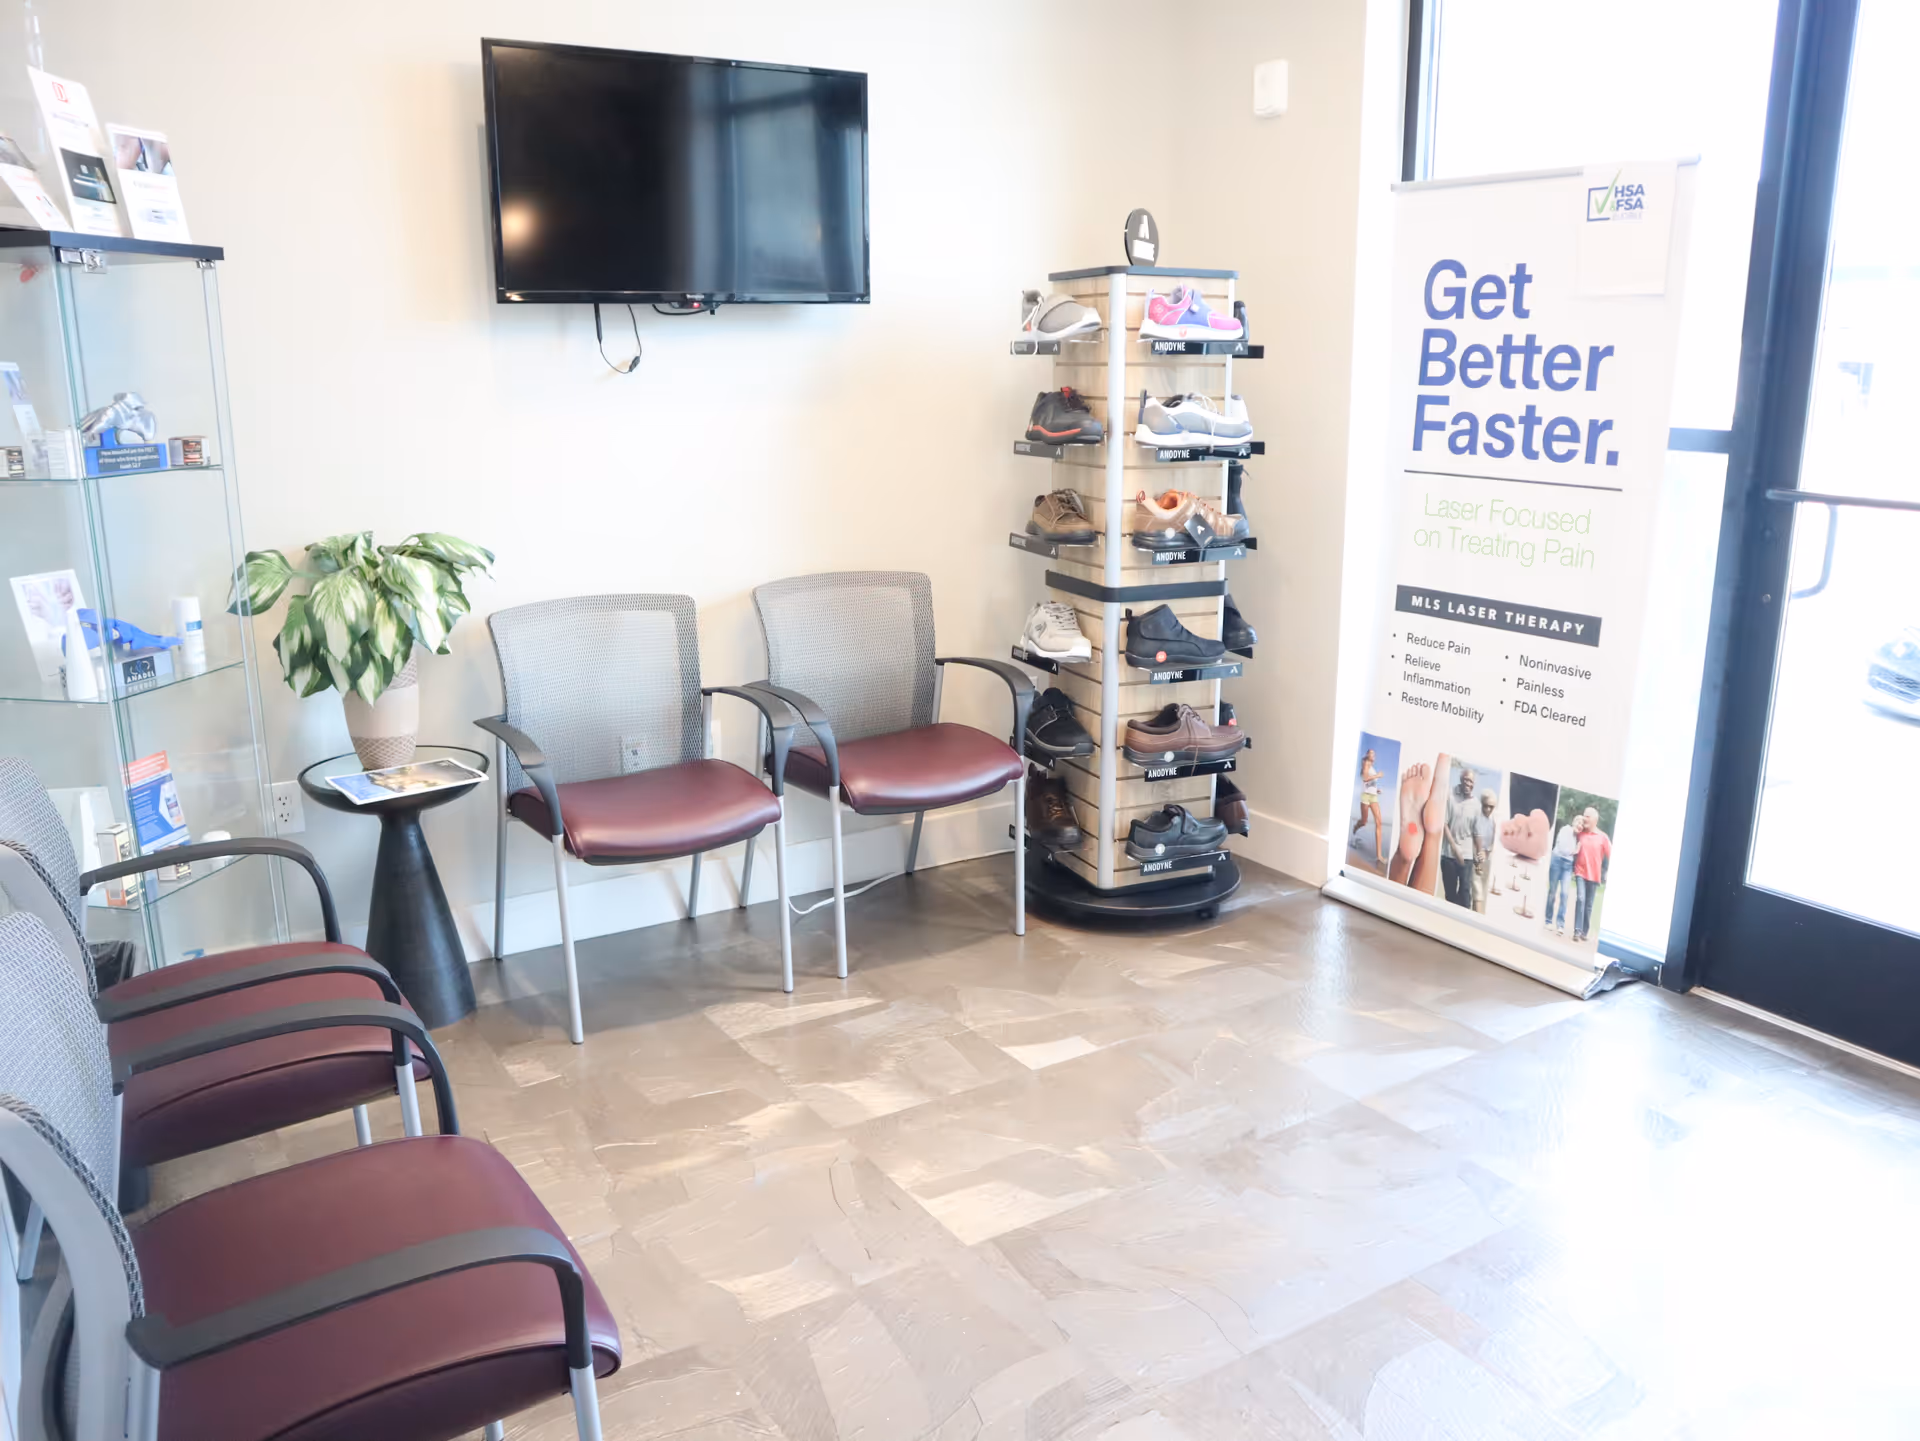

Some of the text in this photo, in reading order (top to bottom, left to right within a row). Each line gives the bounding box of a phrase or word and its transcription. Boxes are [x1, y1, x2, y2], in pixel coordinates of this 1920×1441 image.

[1615, 184, 1645, 198] HSA
[1616, 197, 1644, 211] FSA
[1424, 258, 1533, 321] Get
[1154, 341, 1186, 352] ANODYNE
[1417, 327, 1615, 393] Better
[1411, 393, 1620, 466] Faster.
[1159, 449, 1191, 459] ANODYNE
[1424, 493, 1592, 535] Laser Focused
[1156, 551, 1186, 562] ANODYNE
[1413, 525, 1595, 572] on Treating Pain
[1411, 595, 1585, 636] MLS LASER THERAPY
[1406, 632, 1471, 655] Reduce Pain
[1404, 653, 1441, 672] Relieve
[1519, 654, 1592, 680] Noninvasive
[1153, 670, 1183, 681] ANODYNE
[1402, 670, 1471, 696] Inflammation
[1516, 677, 1565, 699] Painless
[1401, 691, 1485, 724] Restore Mobility
[1513, 699, 1587, 727] FDA Cleared
[1148, 767, 1178, 778] ANODYNE
[1143, 860, 1173, 873] ANODYNE
